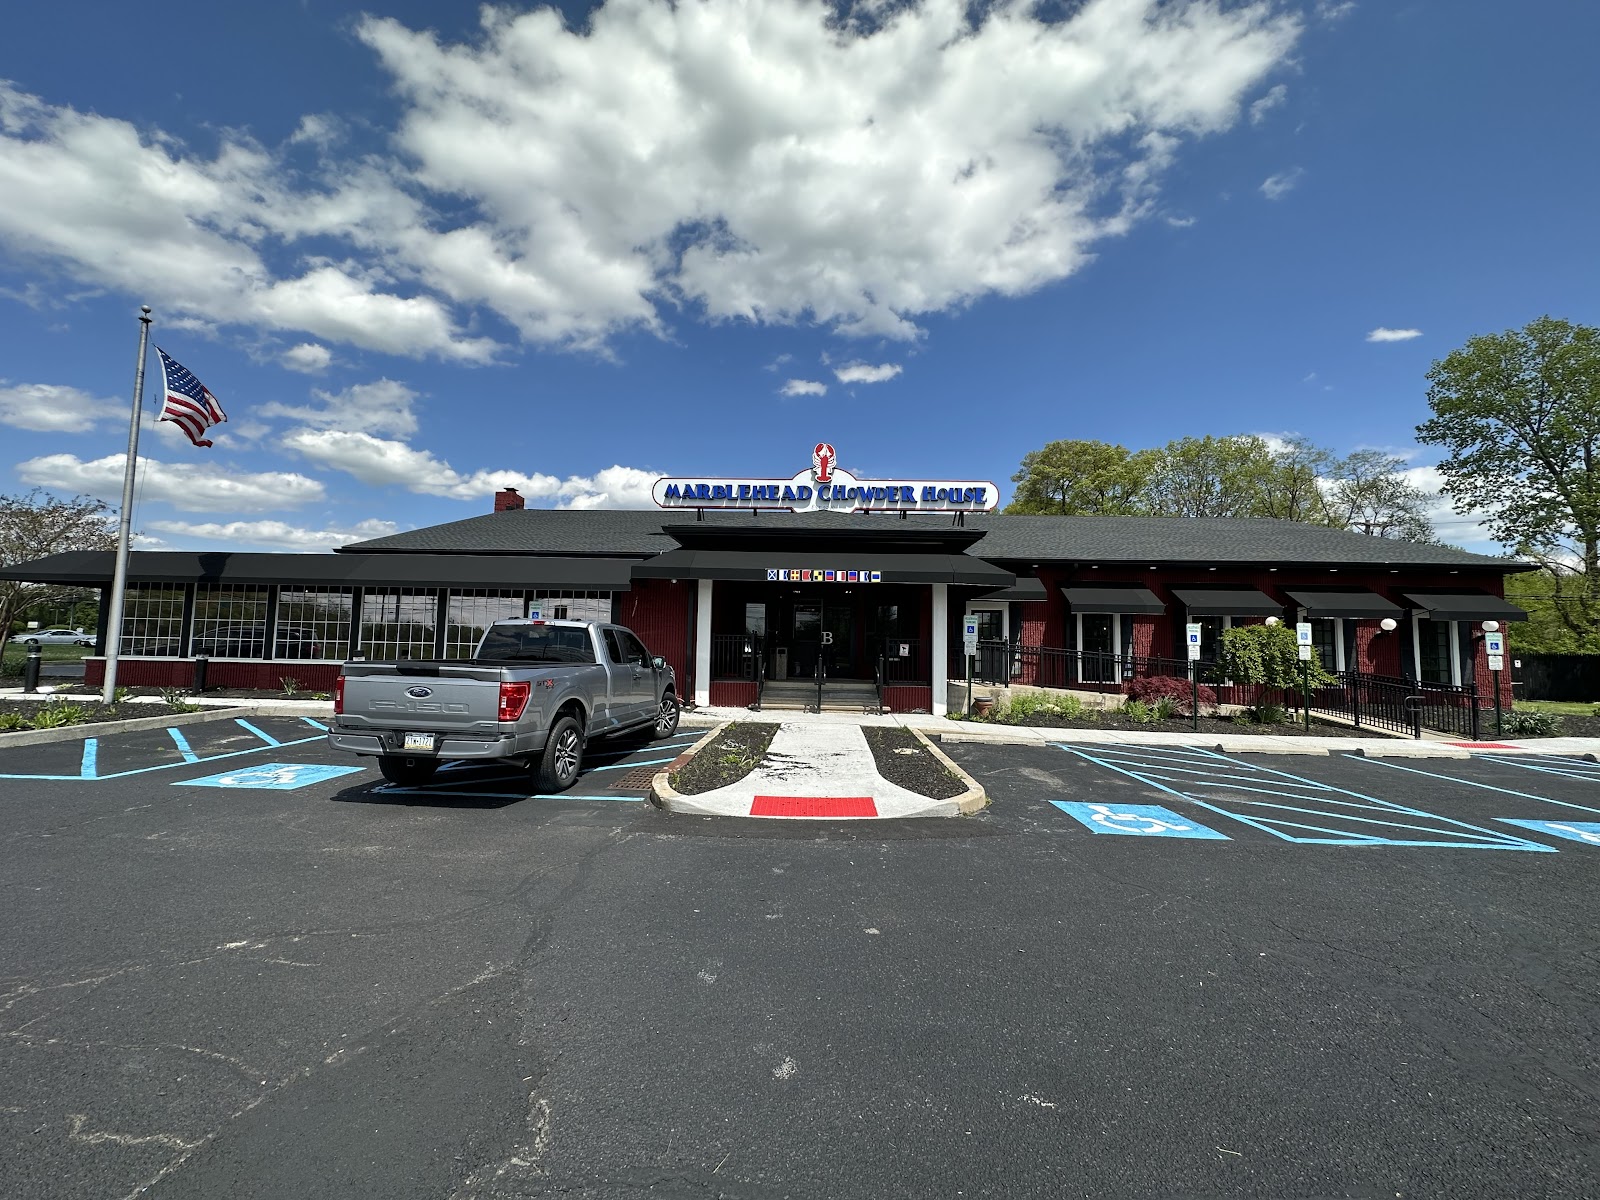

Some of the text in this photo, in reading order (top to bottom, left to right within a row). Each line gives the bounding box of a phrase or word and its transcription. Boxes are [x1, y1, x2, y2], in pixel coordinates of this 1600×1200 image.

[664, 483, 988, 504] MARBLEHEAD CHOWDER HOUSE
[820, 631, 834, 645] B
[368, 699, 470, 714] F-150
